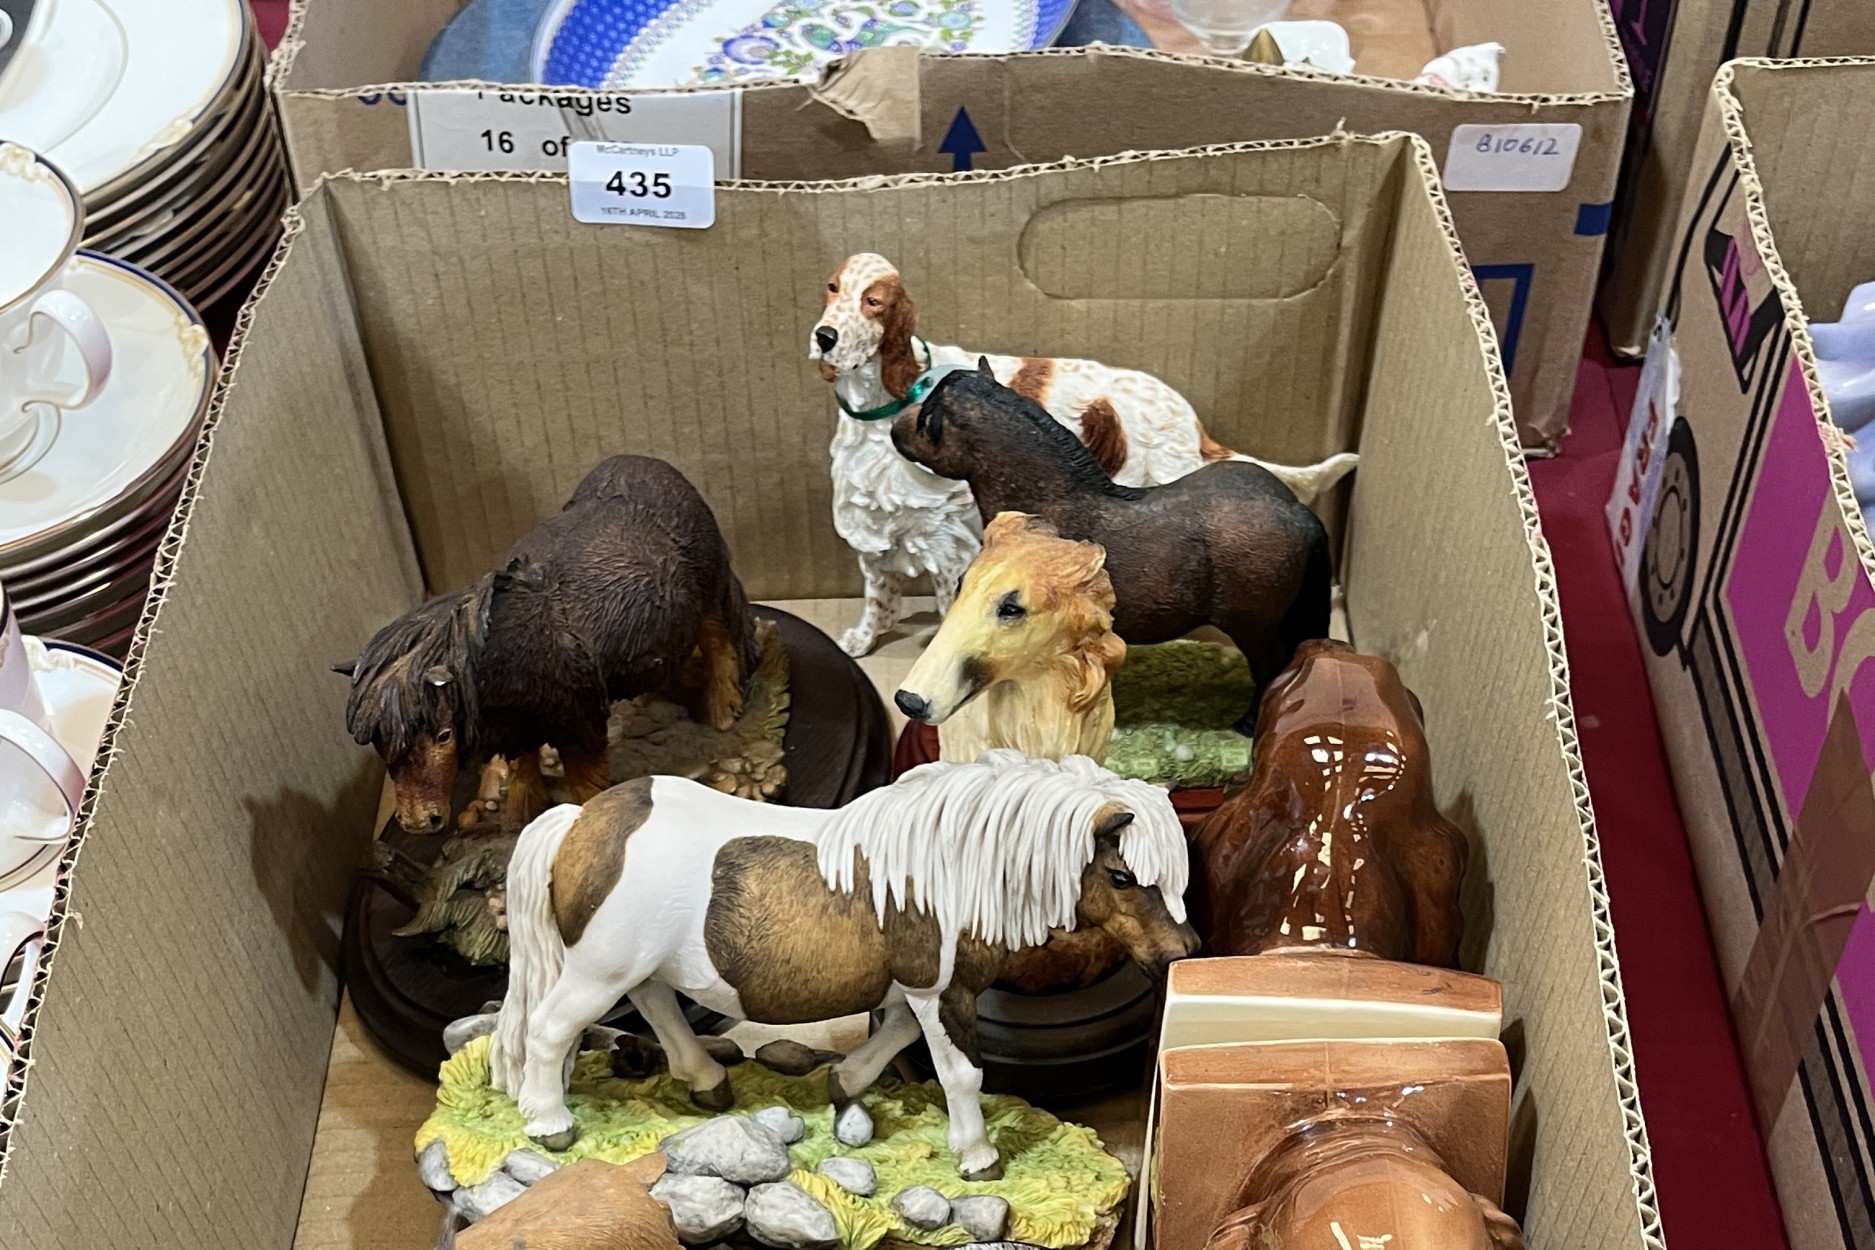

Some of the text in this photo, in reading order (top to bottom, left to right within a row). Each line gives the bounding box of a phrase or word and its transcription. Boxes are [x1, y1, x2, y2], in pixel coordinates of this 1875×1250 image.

[481, 129, 571, 157] 16 of
[658, 147, 680, 157] LLP
[605, 170, 672, 198] 435
